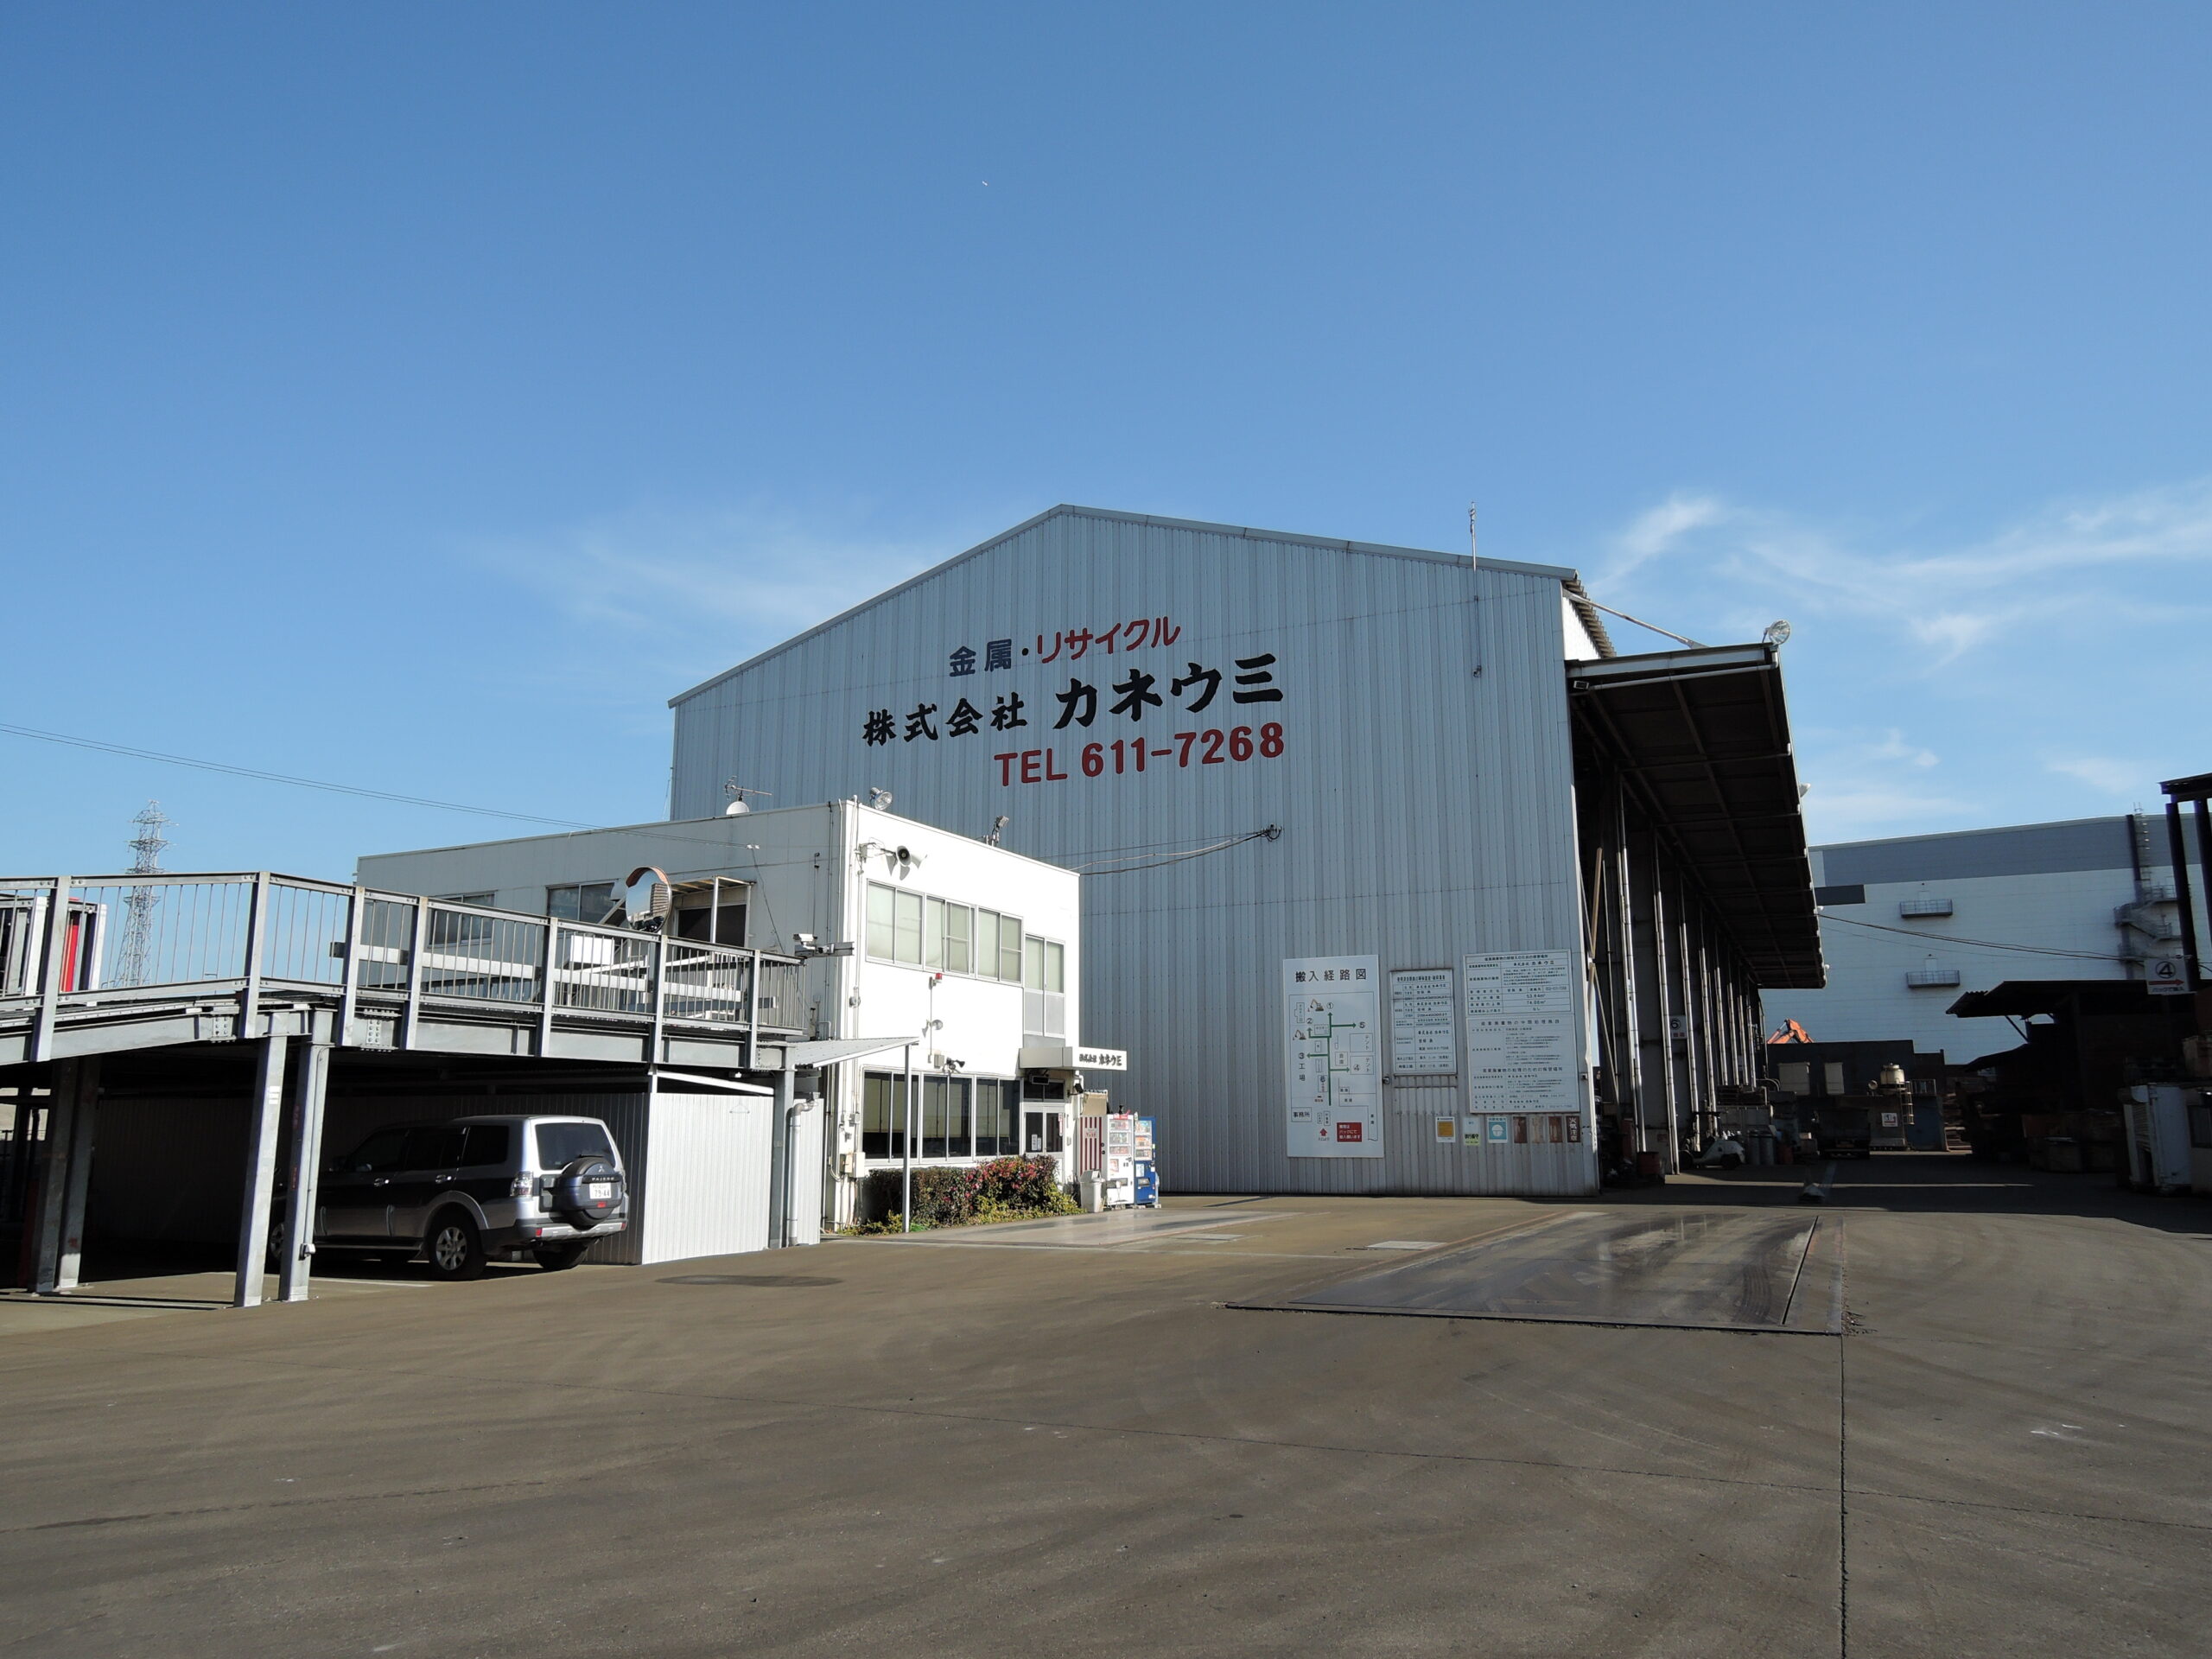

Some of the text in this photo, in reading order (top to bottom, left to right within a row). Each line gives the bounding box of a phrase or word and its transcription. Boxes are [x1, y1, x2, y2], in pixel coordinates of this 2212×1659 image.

[862, 692, 1028, 747] 株式会社
[995, 722, 1284, 786] TEL 611-7268
[1295, 969, 1367, 982] 搬入経路図
